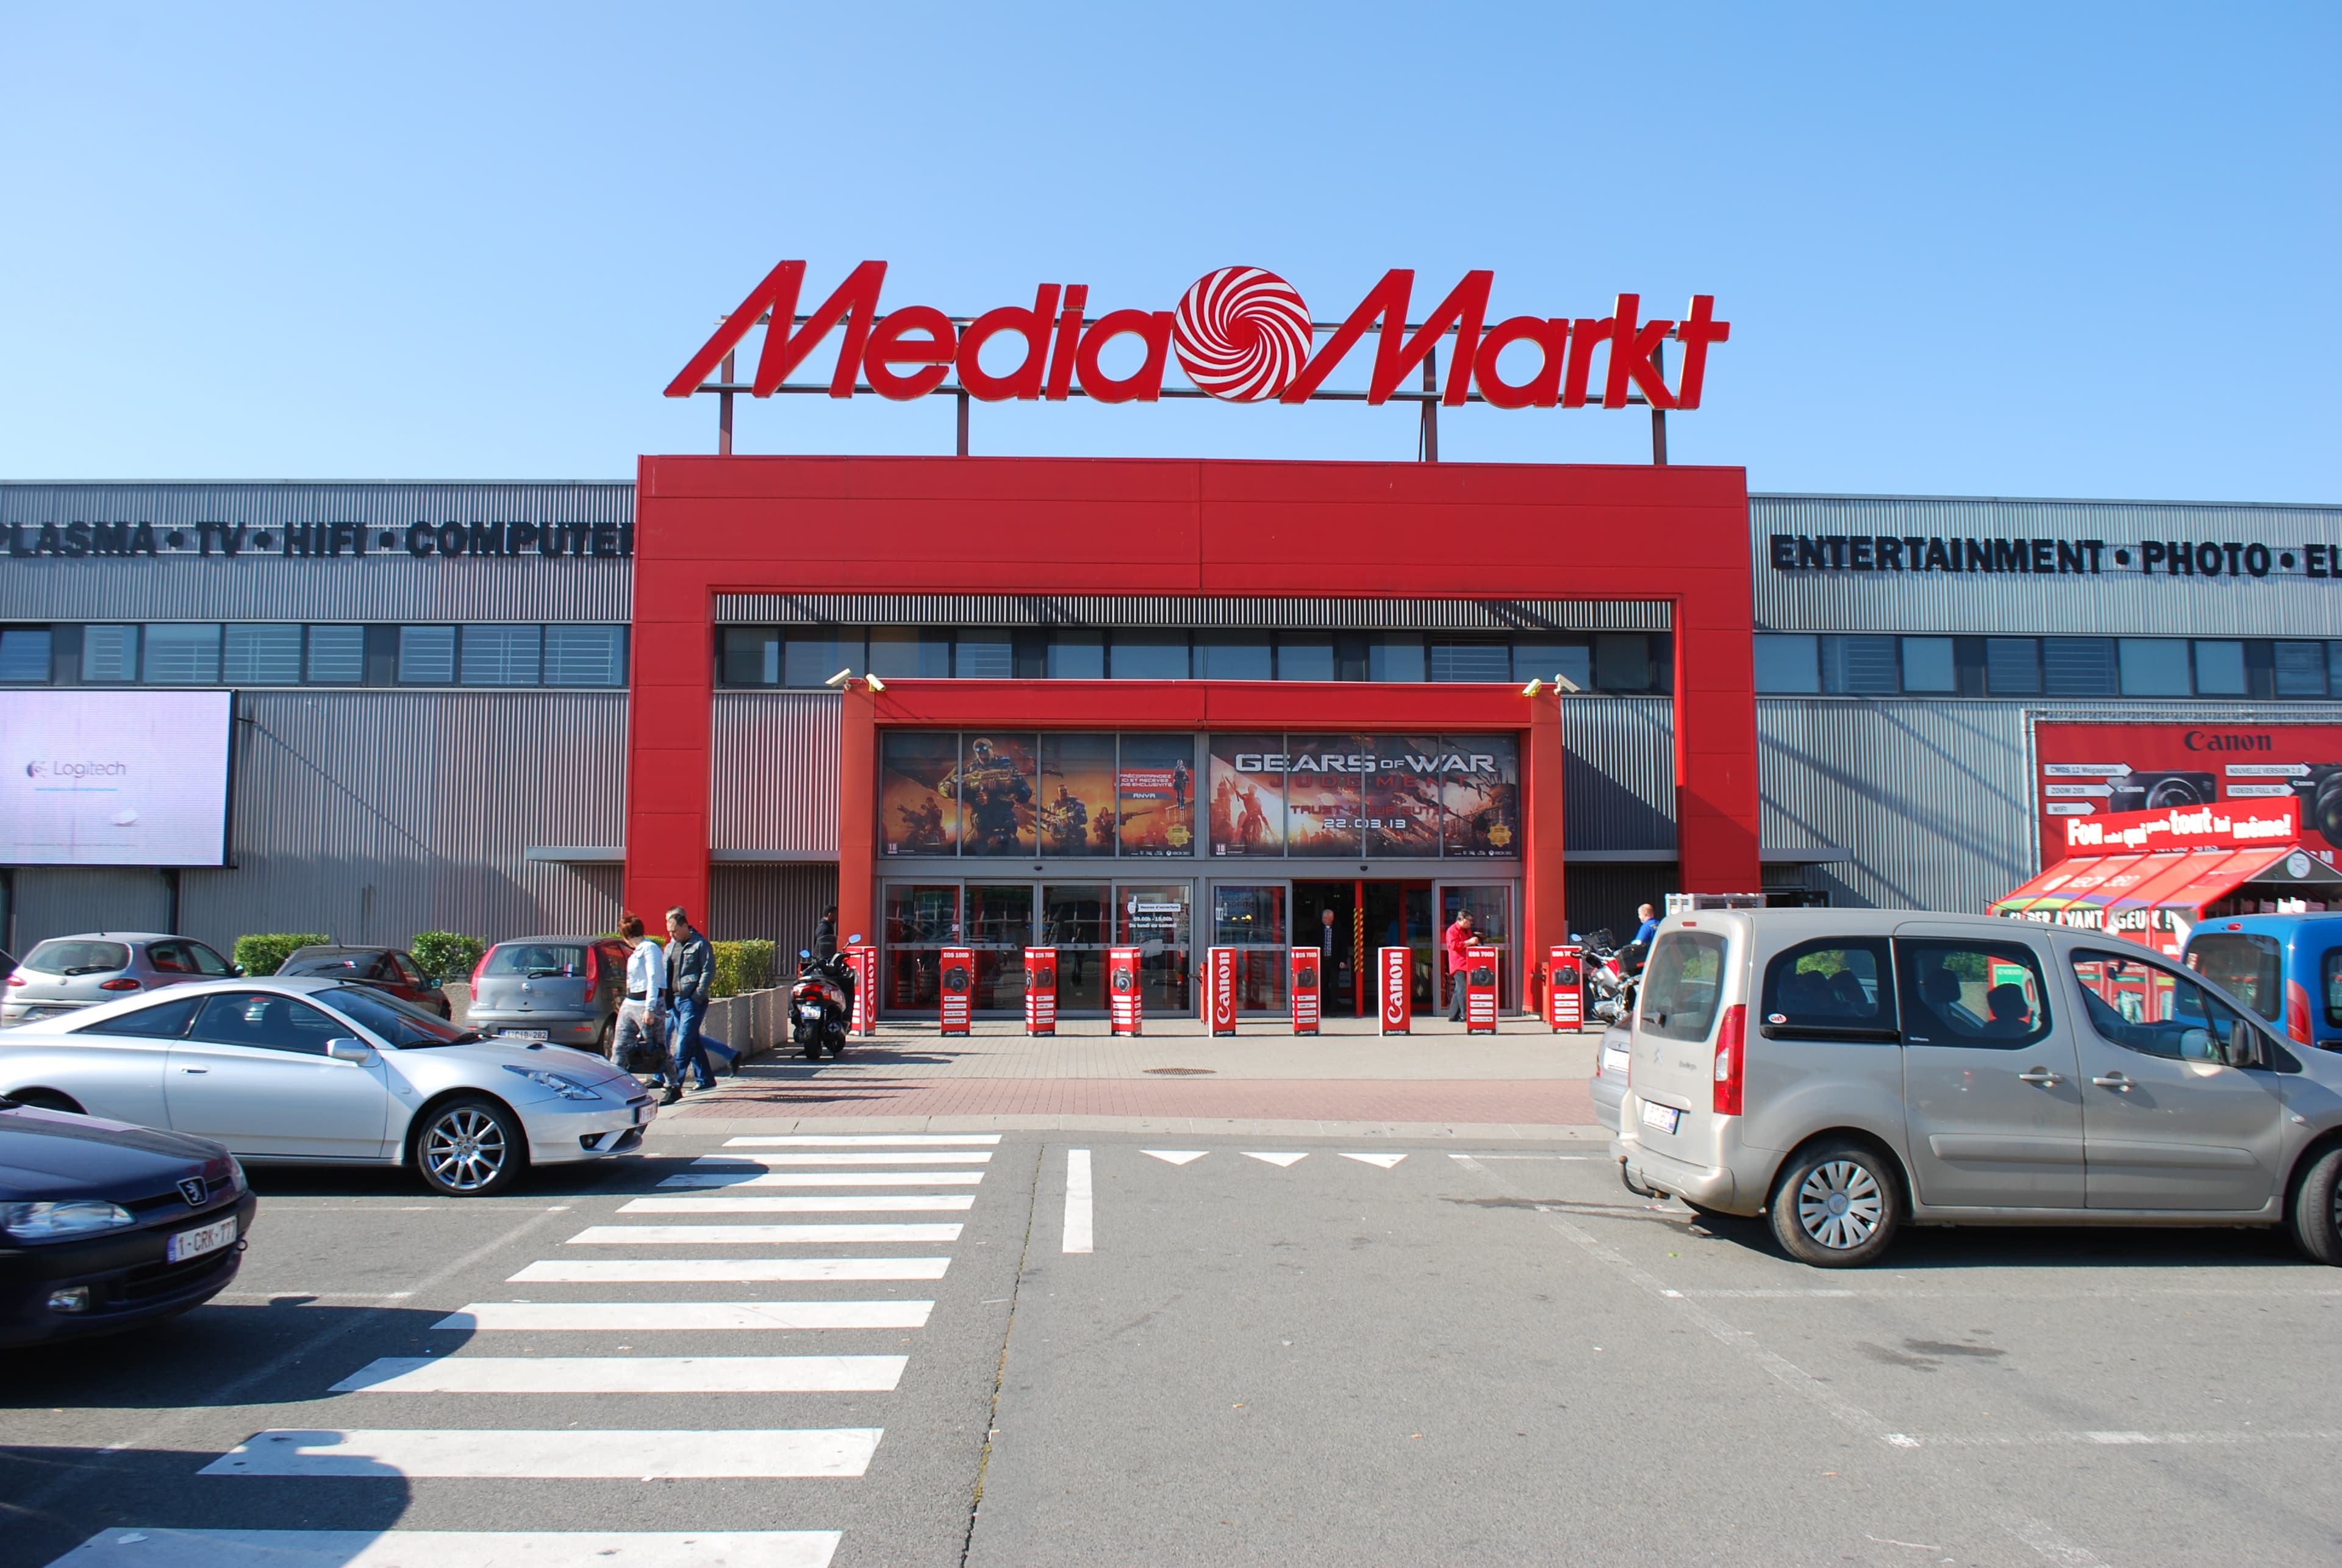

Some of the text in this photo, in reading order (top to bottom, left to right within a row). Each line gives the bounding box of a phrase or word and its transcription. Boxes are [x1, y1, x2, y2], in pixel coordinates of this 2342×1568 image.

[663, 260, 1730, 409] Media Markt
[196, 521, 246, 557] TV
[282, 522, 365, 557] HIFI
[1771, 535, 2104, 574] ENTERTAINMENT
[2141, 540, 2271, 577] PHOTO
[2184, 731, 2272, 751] Canon
[54, 761, 127, 778] Logitech
[1235, 754, 1497, 773] GEARS OF WAR
[1269, 775, 1469, 788] JUDGMENT
[1290, 805, 1342, 815] TRUST
[1348, 805, 1396, 815] YOUR
[1324, 818, 1406, 829] 22.03.13
[2067, 818, 2103, 845] Fou
[2169, 807, 2212, 835] tout
[1217, 952, 1231, 1025] Canon
[1388, 952, 1403, 1024] Canon
[179, 1220, 236, 1256] 1-CRK-777
